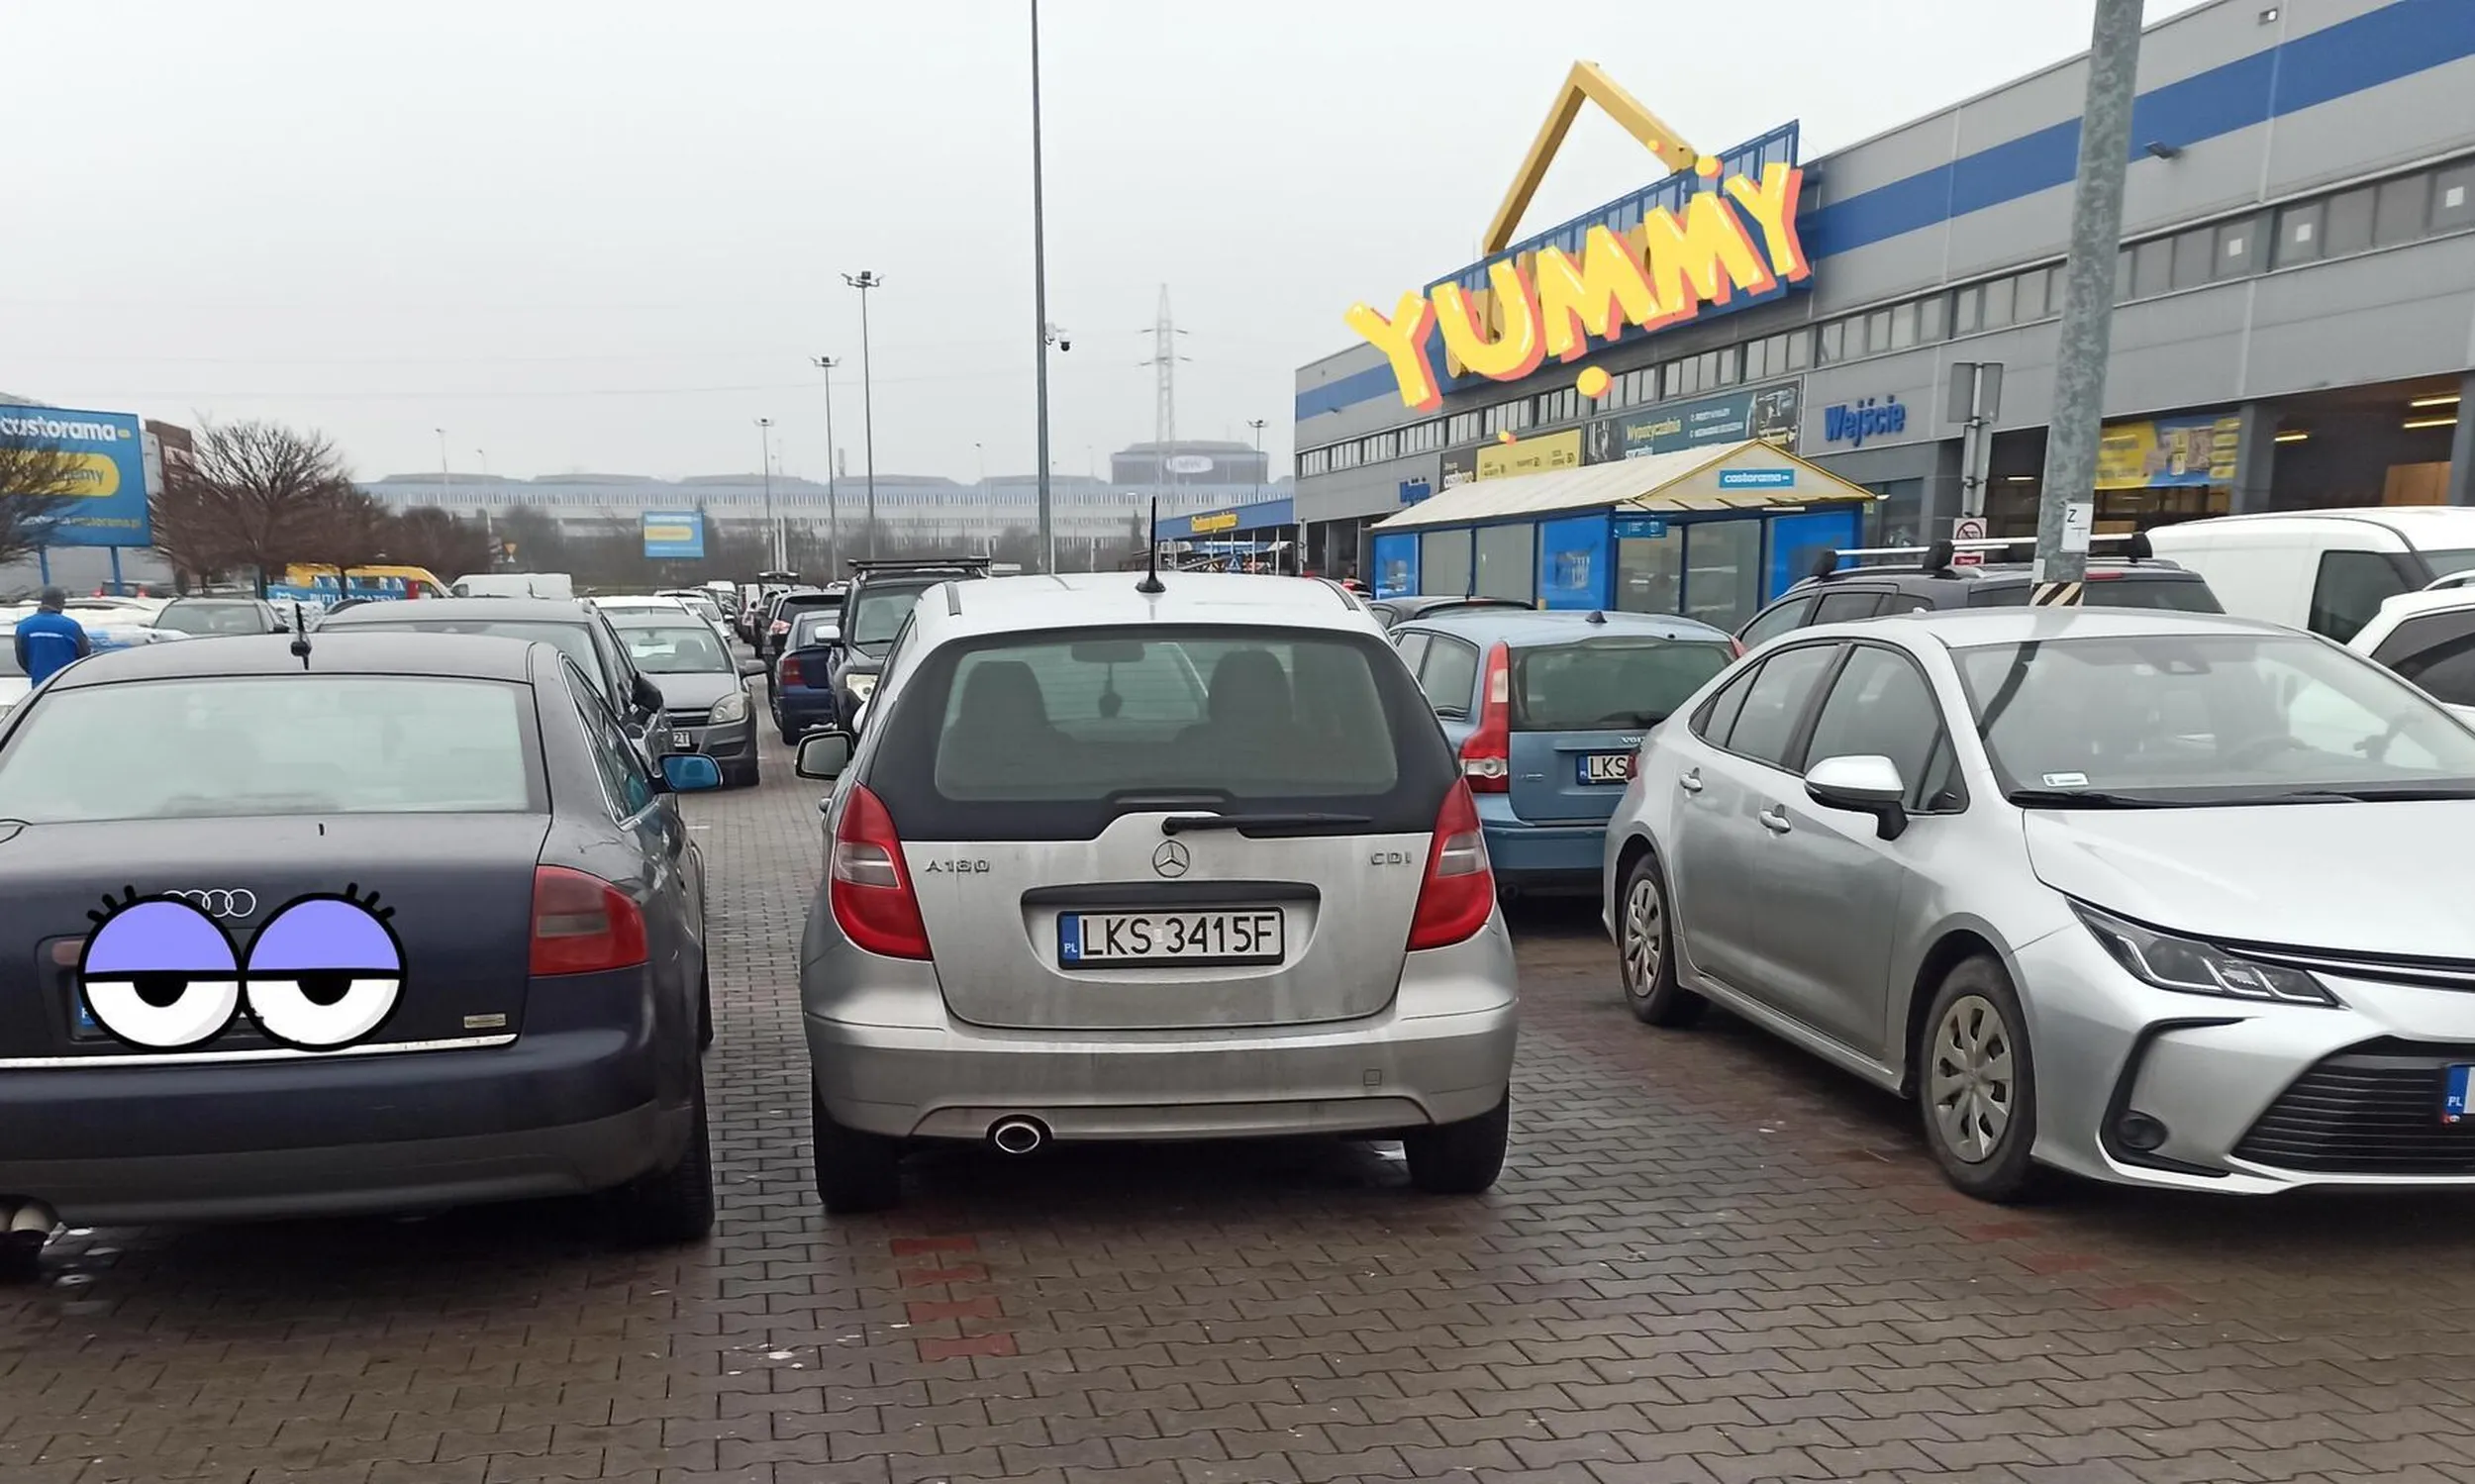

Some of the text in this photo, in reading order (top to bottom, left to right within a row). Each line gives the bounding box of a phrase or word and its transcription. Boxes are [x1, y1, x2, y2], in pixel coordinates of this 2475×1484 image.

[1825, 395, 1907, 447] Wejście
[1725, 472, 1781, 483] castorama
[1590, 756, 1627, 778] LKS
[1370, 851, 1412, 865] CDI
[1082, 916, 1275, 956] LKS 3415F
[1064, 942, 1078, 953] PL
[2447, 1096, 2463, 1107] PL
